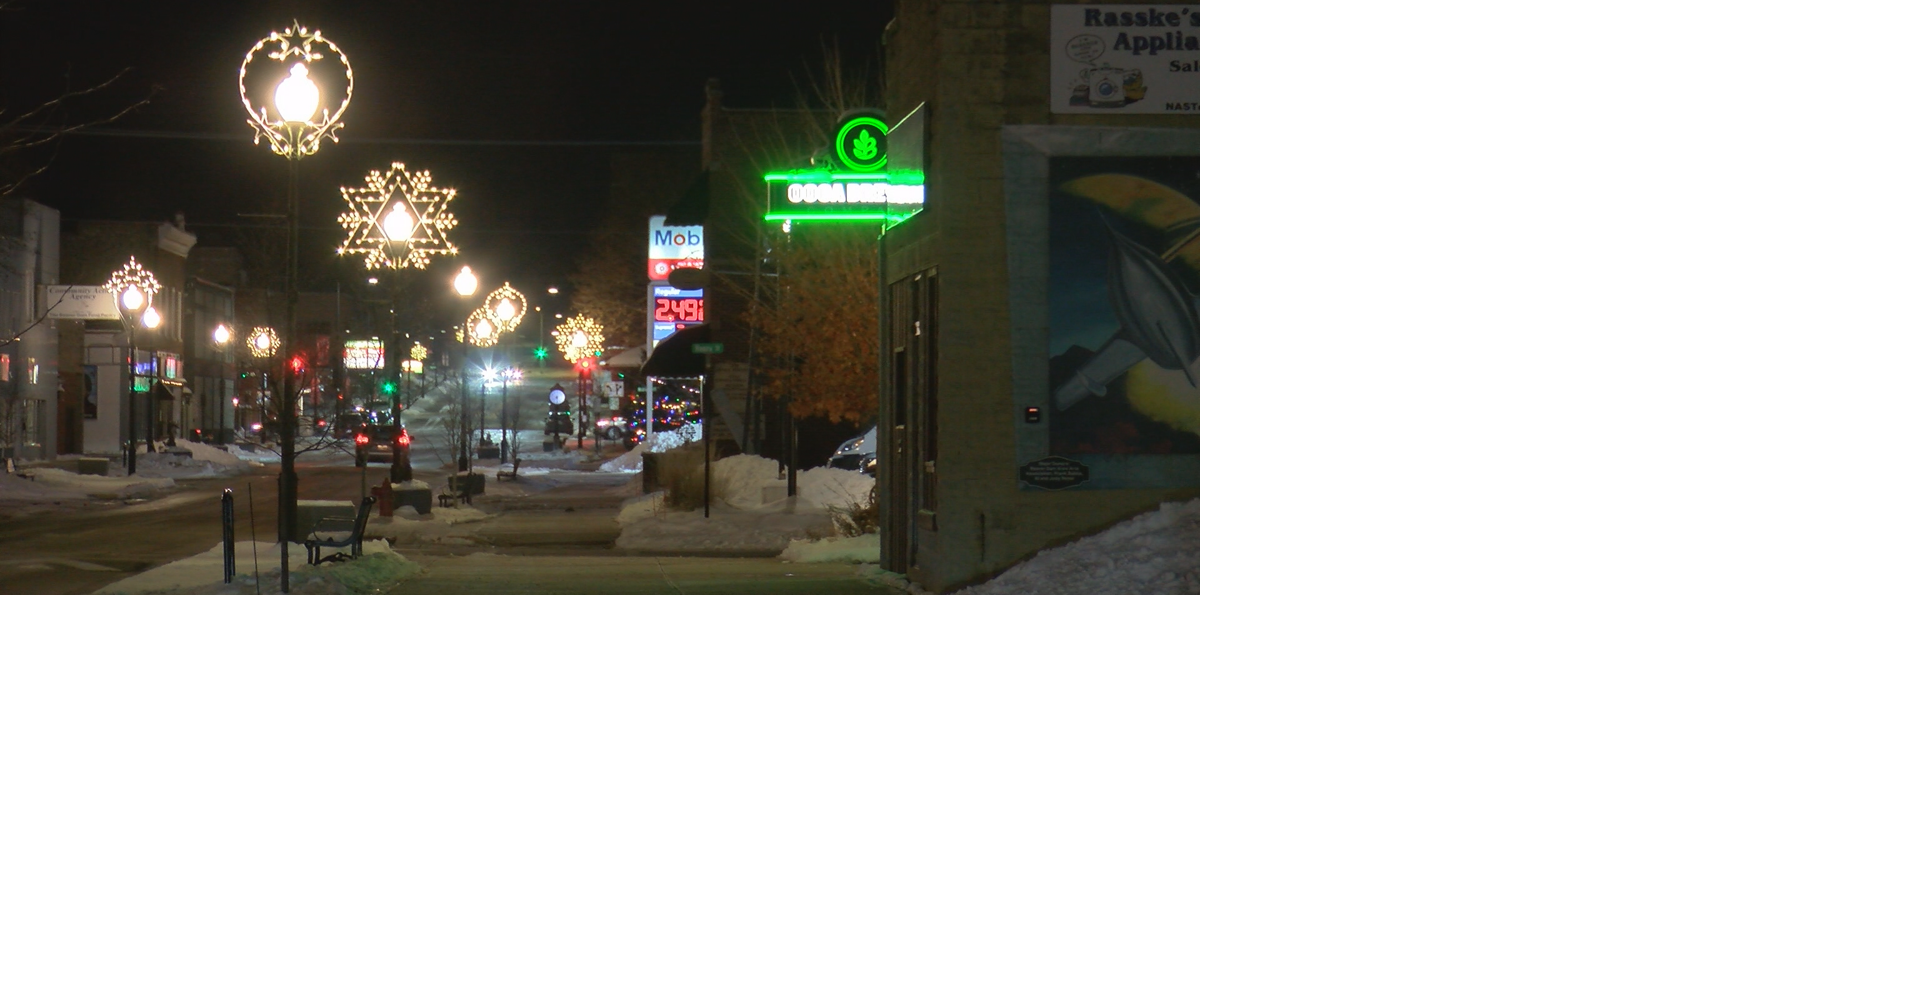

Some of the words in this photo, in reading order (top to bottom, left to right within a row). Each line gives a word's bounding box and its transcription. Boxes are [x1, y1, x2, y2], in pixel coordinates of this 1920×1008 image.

[1084, 8, 1200, 27] Rasske's
[1169, 59, 1200, 72] Sal
[1166, 102, 1200, 111] NAST
[655, 229, 700, 246] Mob
